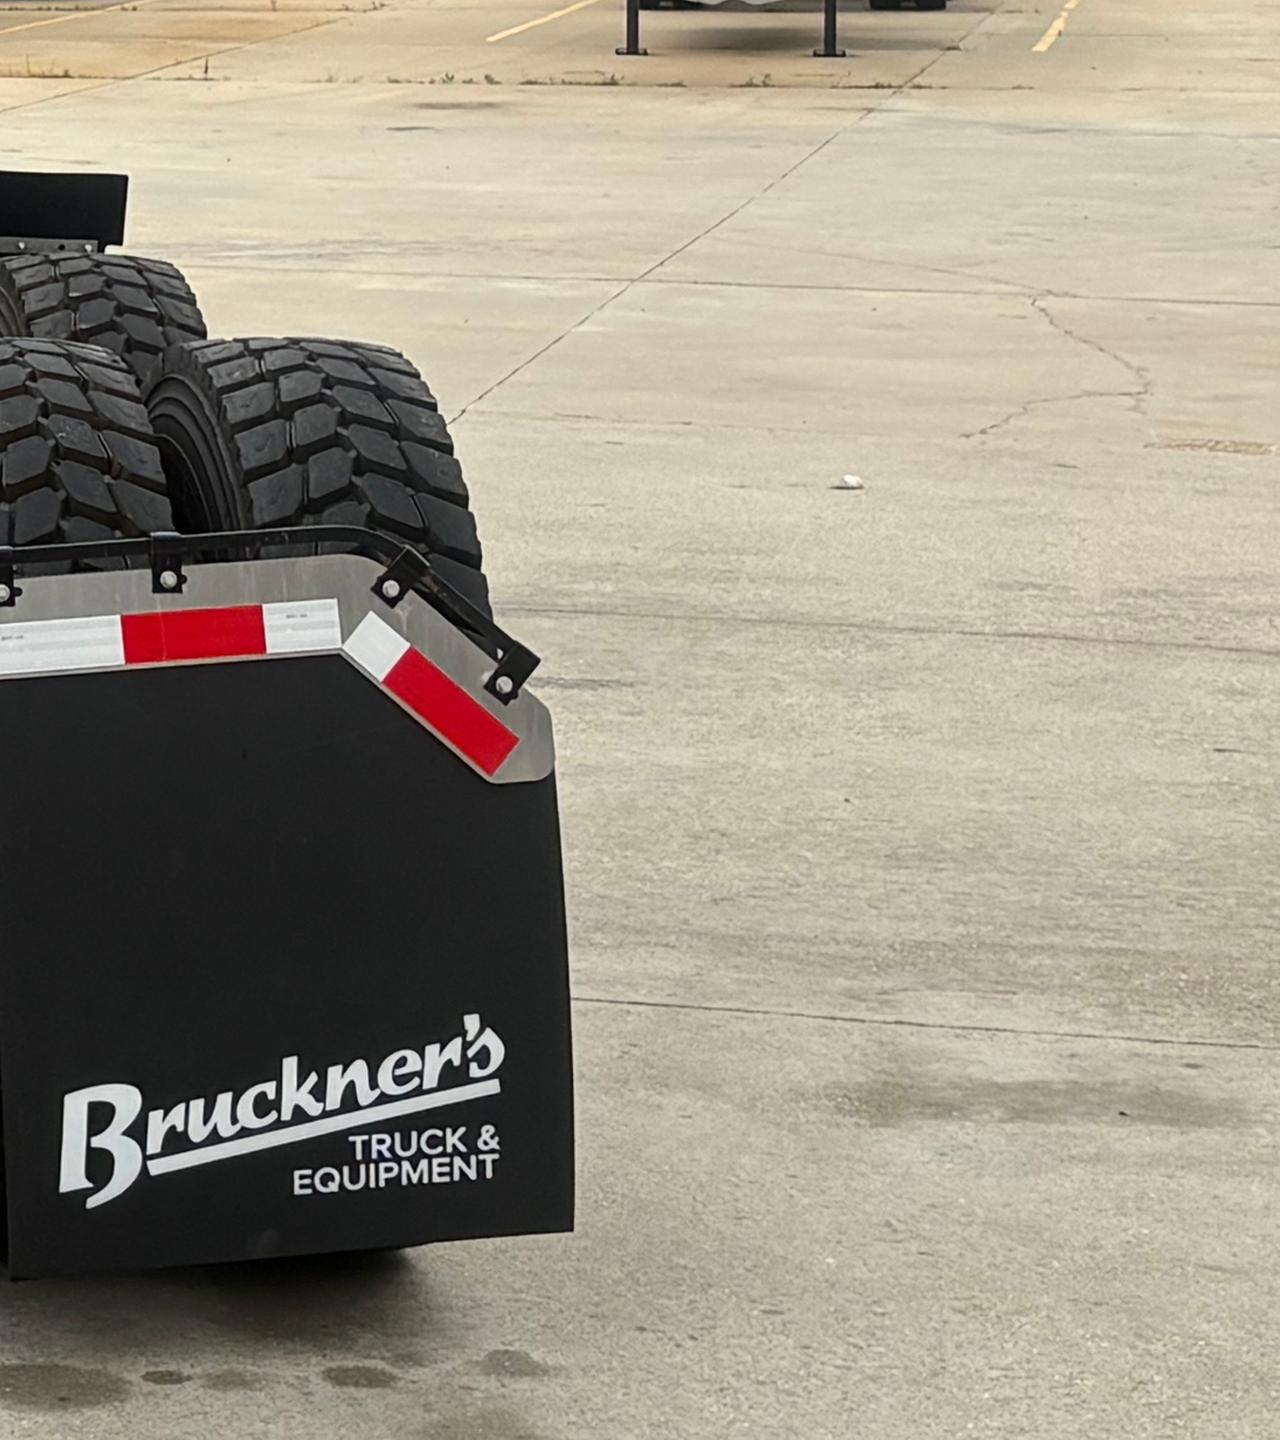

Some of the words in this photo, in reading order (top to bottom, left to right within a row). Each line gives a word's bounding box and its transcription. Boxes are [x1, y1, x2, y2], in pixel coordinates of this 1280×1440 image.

[58, 1013, 506, 1210] Bruckner's
[348, 1126, 468, 1162] TRUCK
[477, 1124, 501, 1151] &
[292, 1153, 501, 1196] EQUIPMENT
